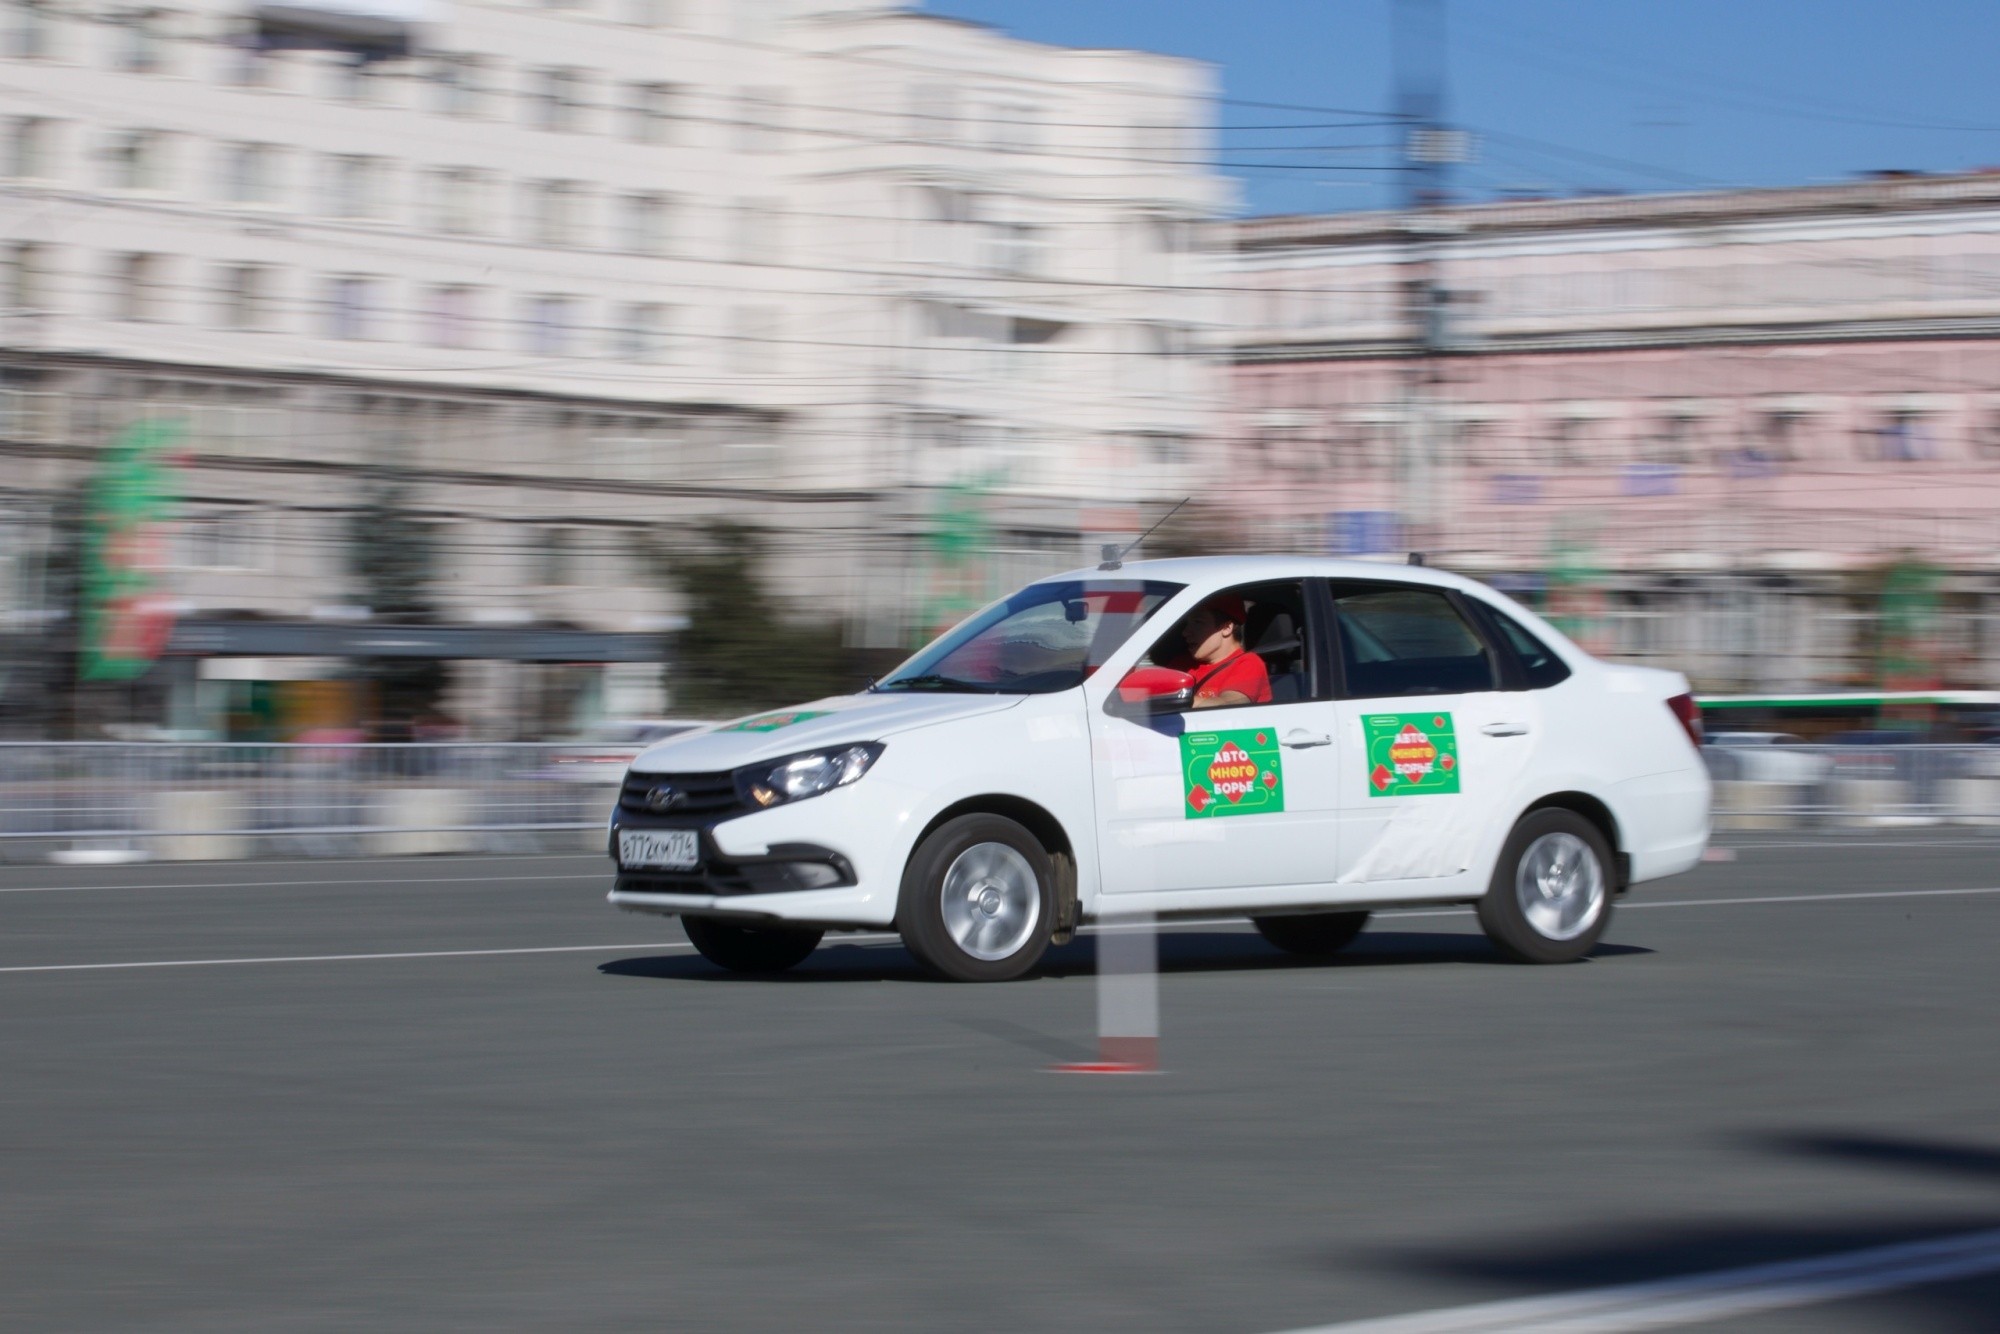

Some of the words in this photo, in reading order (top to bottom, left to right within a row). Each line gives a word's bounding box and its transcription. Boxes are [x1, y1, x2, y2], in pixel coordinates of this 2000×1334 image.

[1213, 750, 1249, 763] АВТО
[1210, 765, 1255, 779] МНОГО
[1213, 780, 1255, 795] БОРЬЕ
